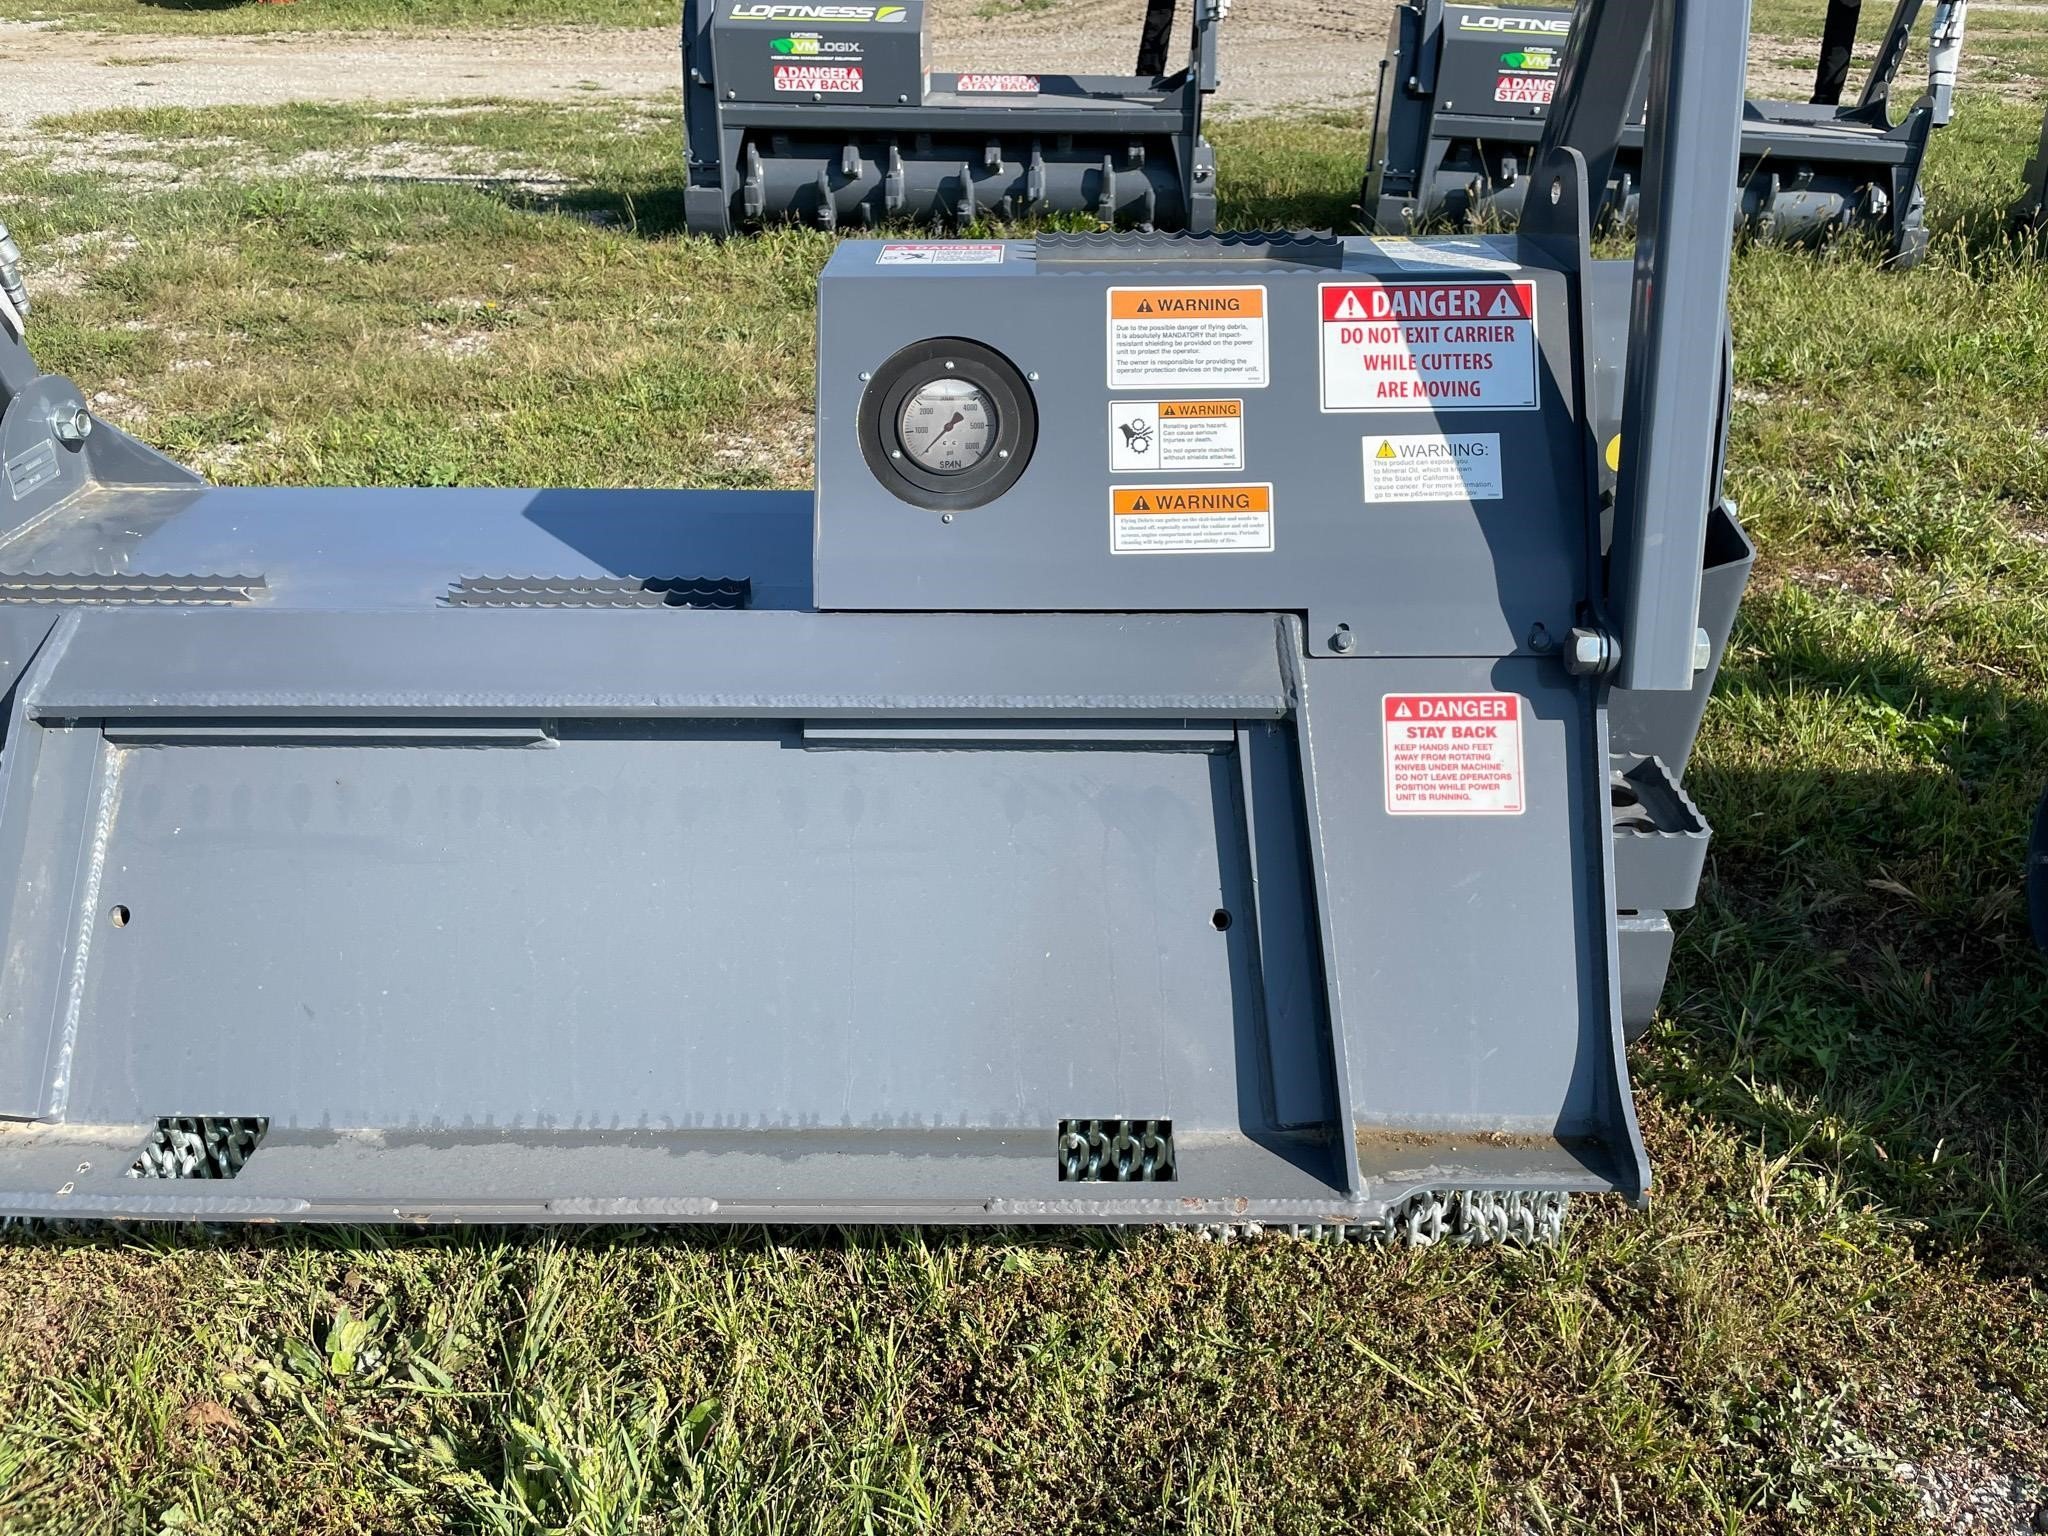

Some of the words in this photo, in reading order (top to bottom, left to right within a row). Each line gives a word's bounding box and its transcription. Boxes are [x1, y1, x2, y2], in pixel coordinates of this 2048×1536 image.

[731, 4, 876, 18] LOFTNESS
[1460, 15, 1571, 31] LOFTNE
[788, 66, 850, 79] DANGER
[778, 79, 815, 90] STAY
[820, 79, 859, 91] BACK
[972, 75, 1028, 83] DANGER
[1511, 78, 1556, 91] DANG
[961, 82, 996, 90] STAY
[1498, 89, 1538, 102] STAY
[1158, 298, 1240, 311] WARNING
[1372, 289, 1481, 317] DANGER
[1150, 324, 1175, 332] possible
[1341, 327, 1363, 344] DO
[1368, 327, 1400, 344] NOT
[1406, 327, 1440, 344] EXIT
[1444, 326, 1515, 343] CARRIER
[1145, 340, 1173, 348] shielding
[1364, 354, 1417, 371] WHILE
[1422, 353, 1493, 370] CUTTERS
[1377, 381, 1409, 399] ARE
[1413, 380, 1481, 398] MOVING
[963, 403, 978, 411] 4000
[1179, 404, 1237, 416] WARNING
[914, 426, 929, 434] 1000
[970, 422, 985, 430] 5000
[1400, 442, 1489, 458] WARNING:
[1389, 460, 1414, 468] product
[1156, 493, 1250, 510] WARNING
[1418, 700, 1507, 718] DANGER
[1406, 726, 1447, 739] STAY
[1452, 726, 1498, 739] BACK
[1394, 743, 1417, 751] KEEP
[1419, 743, 1449, 751] HANDS
[1451, 743, 1470, 751] AND
[1472, 743, 1494, 751] FEET
[1394, 753, 1418, 761] AWAY
[1421, 753, 1446, 761] FROM
[1449, 753, 1491, 761] ROTATING
[1395, 763, 1426, 771] KNIVES
[1428, 763, 1459, 771] UNDER
[1461, 763, 1502, 771] MACHINE
[1395, 773, 1409, 781] DO
[1411, 773, 1429, 781] NOT
[1430, 773, 1458, 781] LEAVE
[1459, 773, 1513, 781] OPERATORS
[1395, 783, 1437, 791] POSITION
[1438, 783, 1466, 791] WHILE
[1468, 783, 1501, 791] POWER
[1396, 793, 1416, 801] UNIT
[1418, 793, 1427, 801] IS
[1429, 793, 1472, 801] RUNNING.
